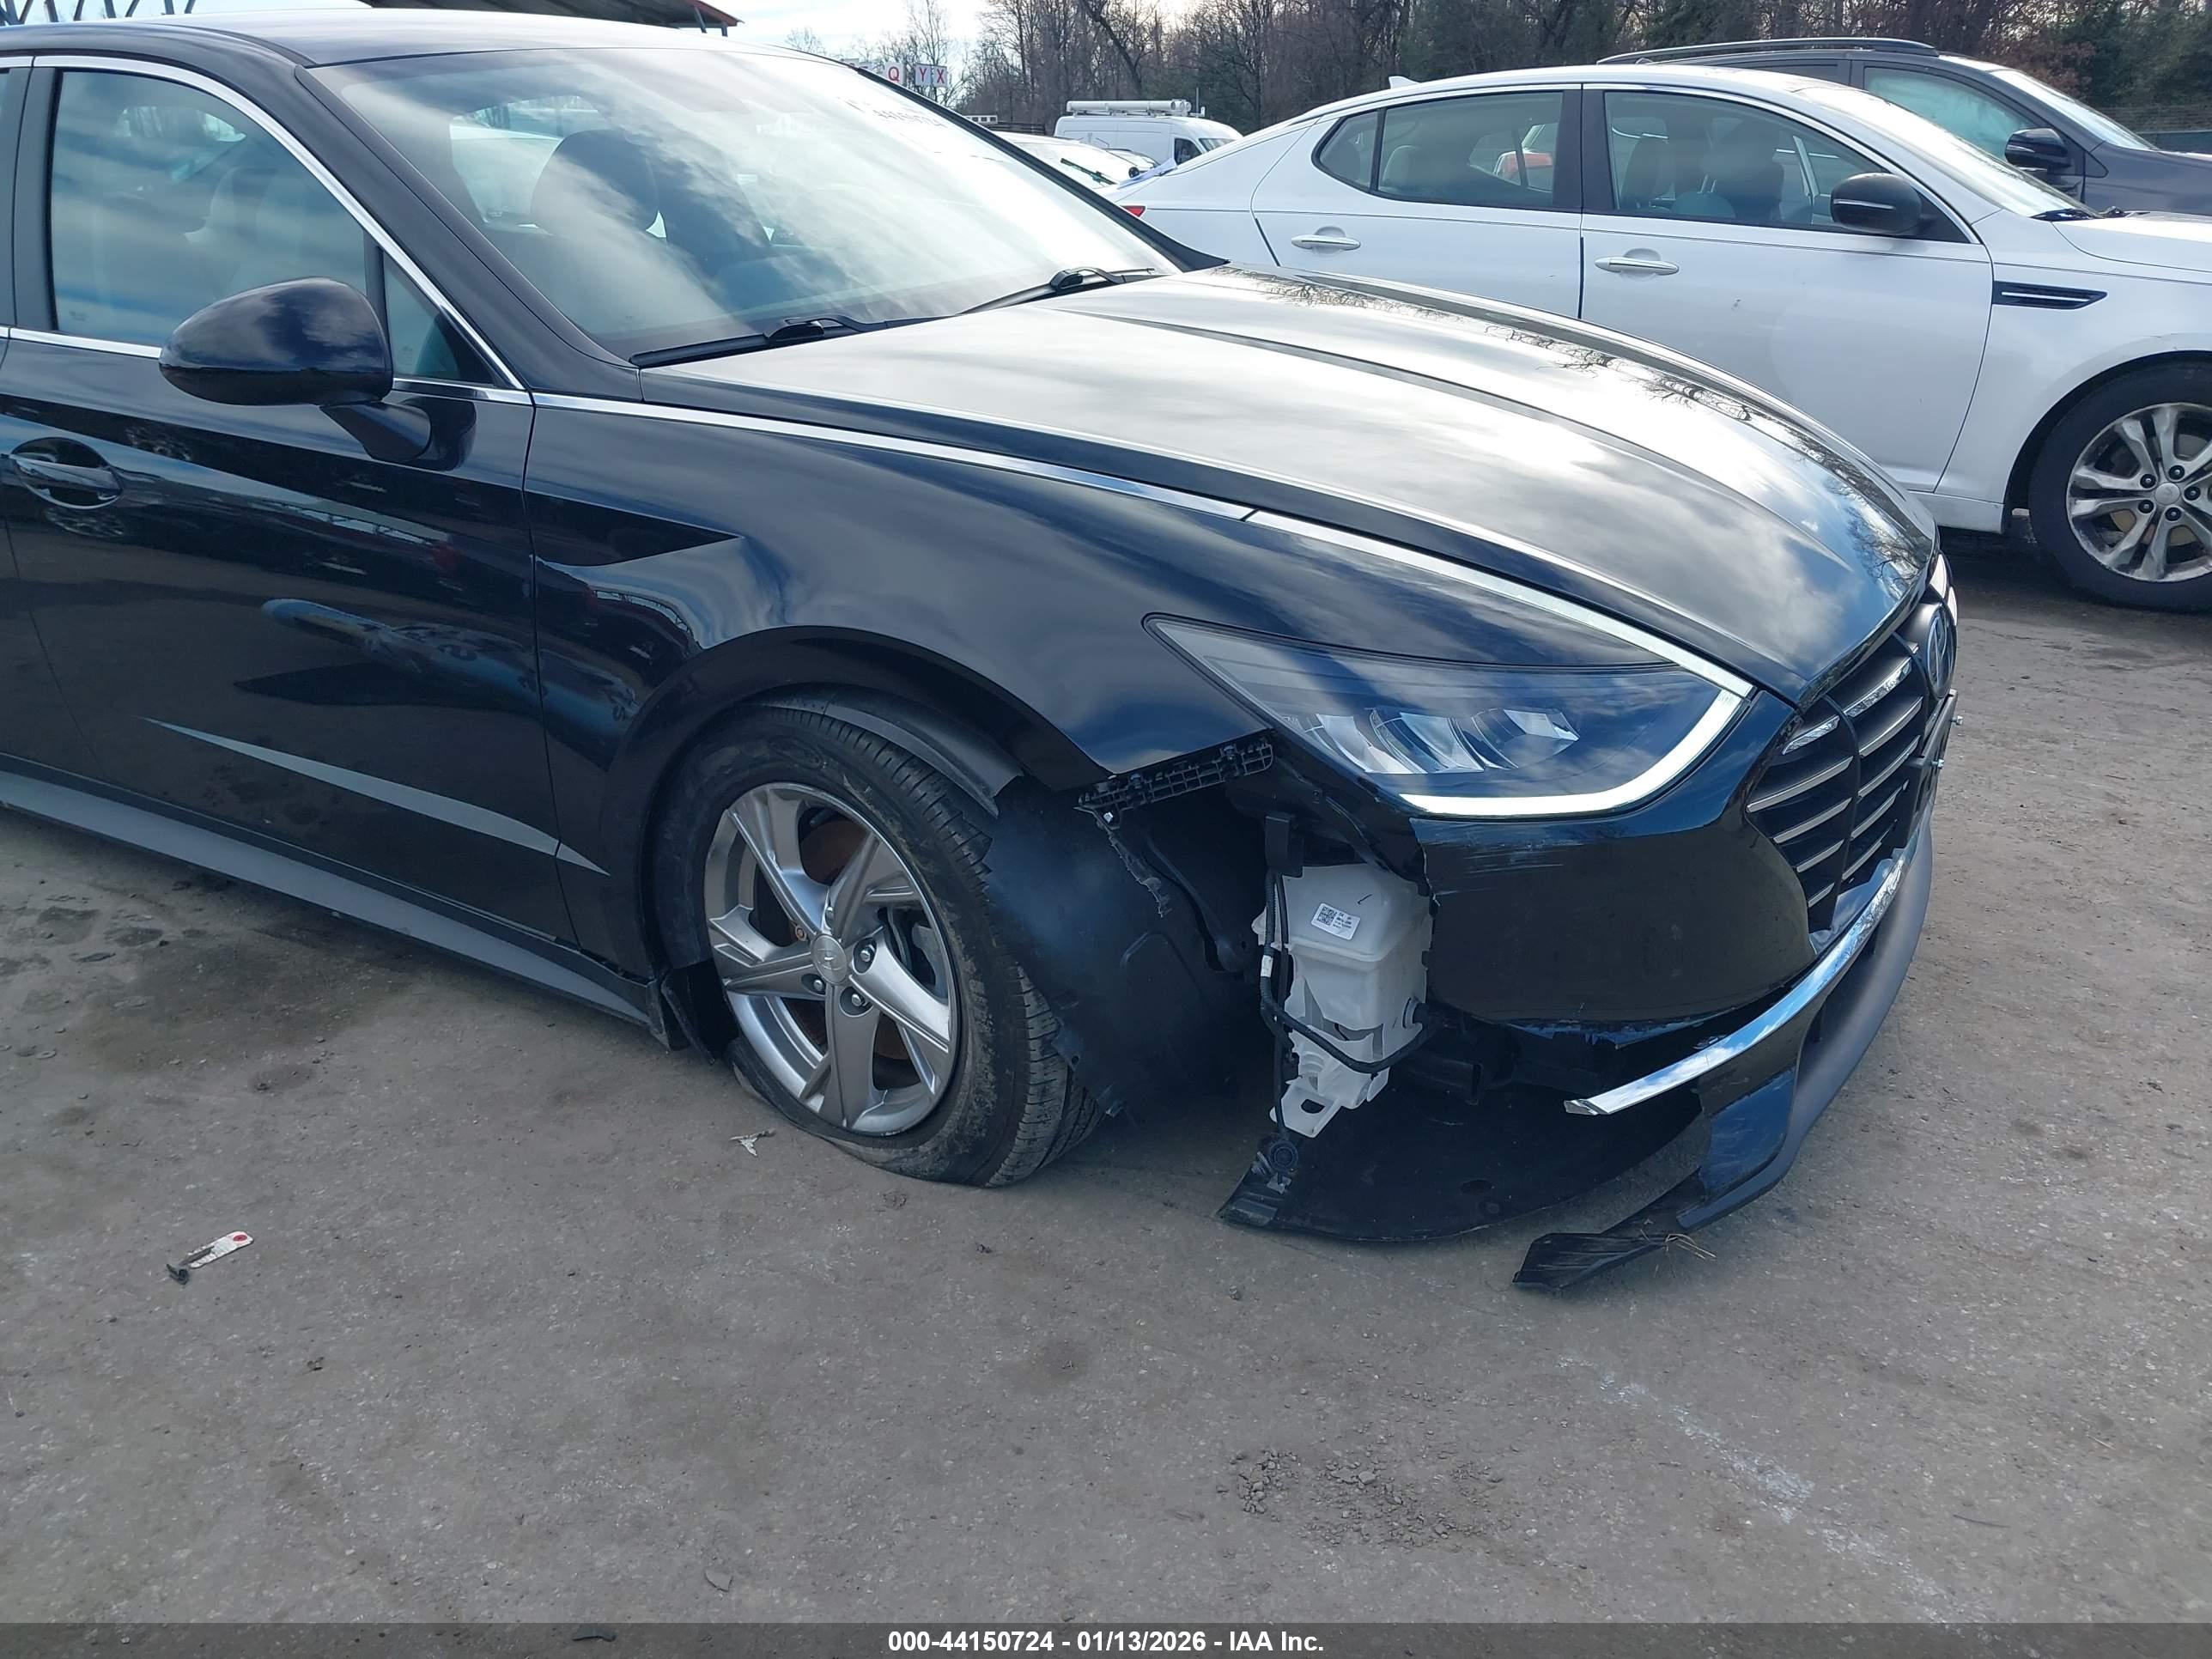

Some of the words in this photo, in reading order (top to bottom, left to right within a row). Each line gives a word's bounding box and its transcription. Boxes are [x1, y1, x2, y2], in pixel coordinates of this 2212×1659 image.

[888, 66, 900, 82] Q
[919, 67, 927, 82] Y
[937, 69, 945, 83] X
